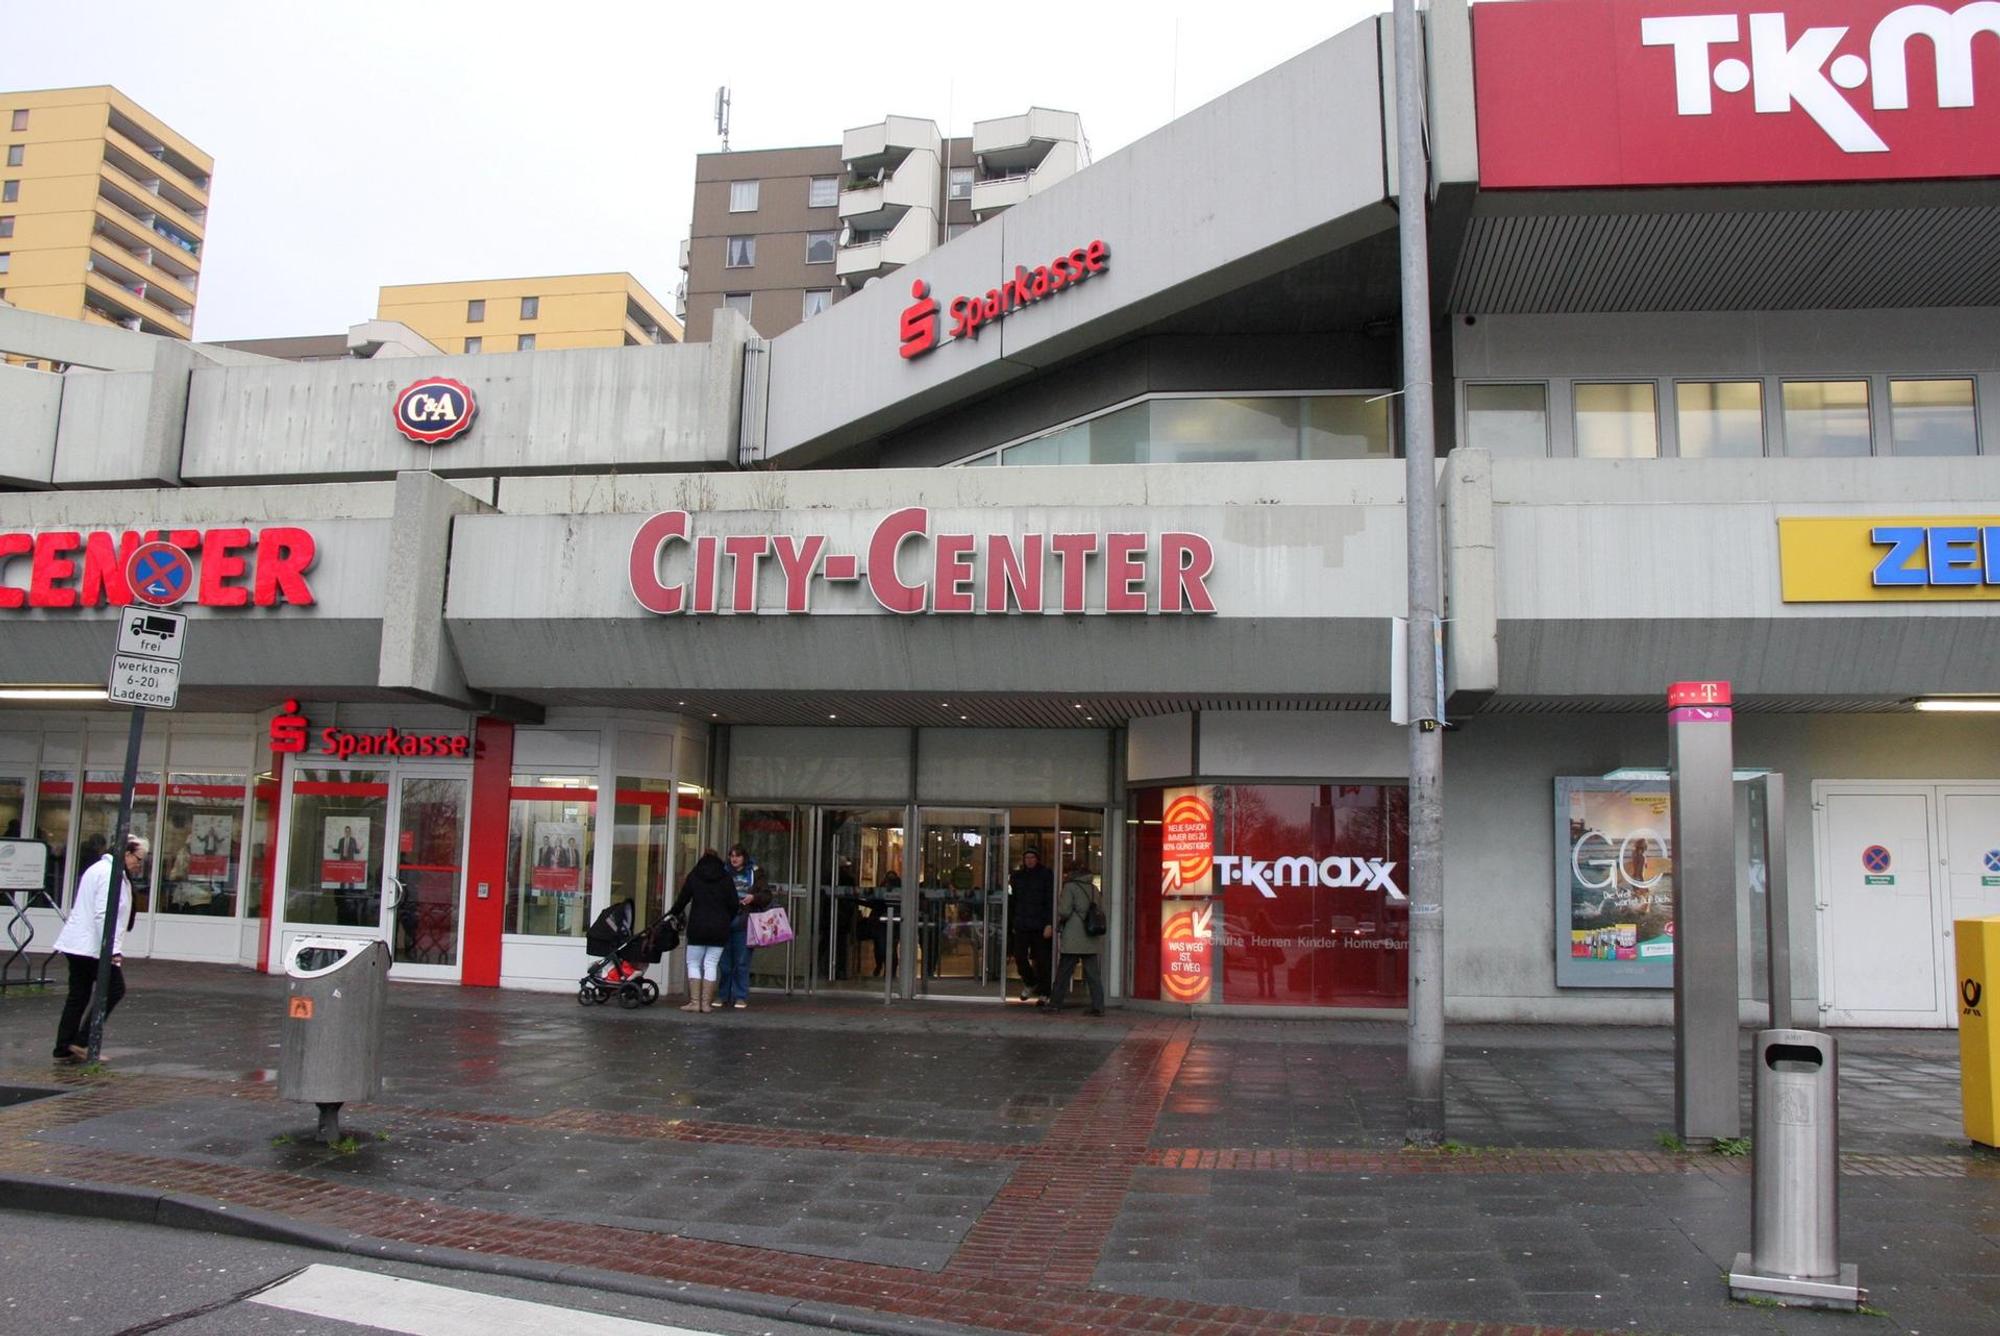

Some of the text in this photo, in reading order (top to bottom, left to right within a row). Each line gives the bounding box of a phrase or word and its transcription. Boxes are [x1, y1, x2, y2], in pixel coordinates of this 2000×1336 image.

[949, 239, 1111, 338] Sparkasse
[407, 393, 457, 421] C&A
[141, 640, 161, 652] frei
[113, 686, 171, 704] Ladezone
[1425, 720, 1434, 730] 13
[322, 725, 469, 760] Sparkasse
[1572, 829, 1668, 889] GO
[1168, 942, 1204, 952] WAS WEG
[1251, 935, 1291, 948] Herren
[1298, 936, 1337, 949] Kinder
[1344, 937, 1380, 949] Home
[1182, 963, 1201, 972] WEG
